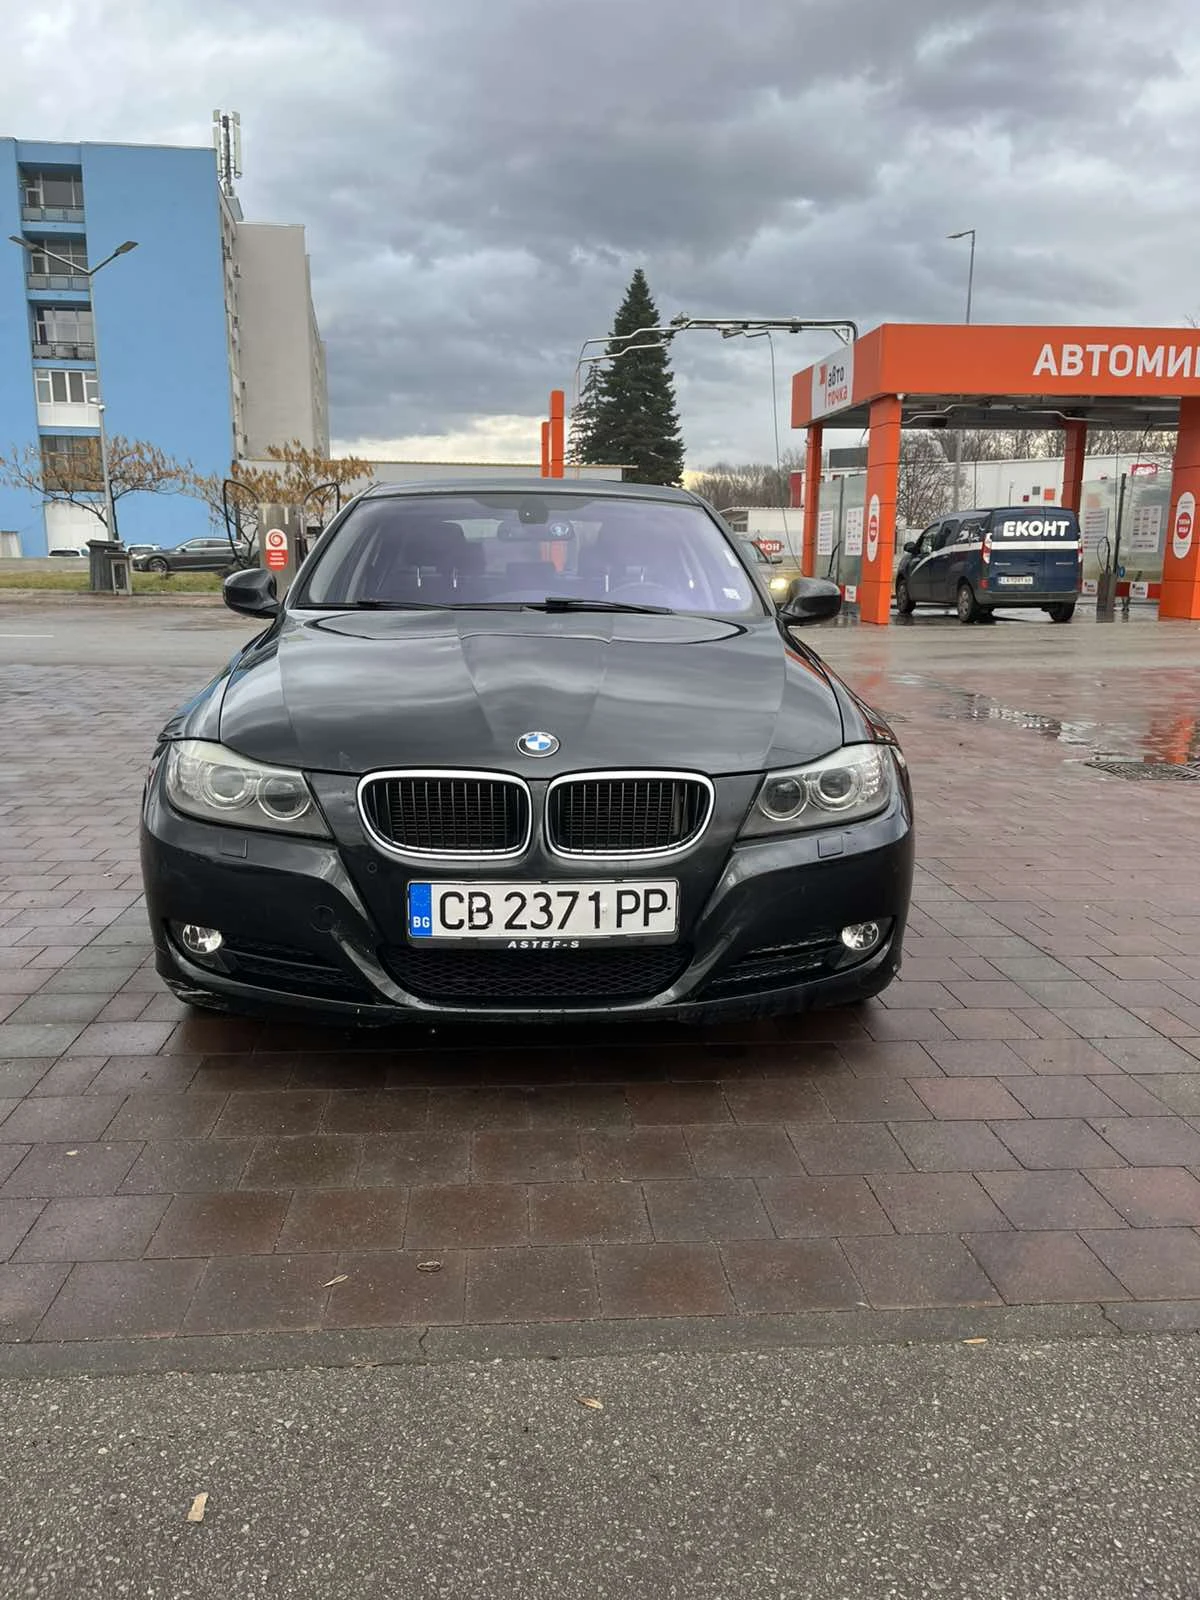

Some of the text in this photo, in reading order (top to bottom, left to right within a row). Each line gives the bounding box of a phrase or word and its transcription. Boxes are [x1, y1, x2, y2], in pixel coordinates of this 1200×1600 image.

[1032, 343, 1200, 378] АВТОМИ
[1003, 520, 1070, 537] ЕКОНТ
[440, 887, 669, 931] CB 2371 PP
[413, 916, 431, 929] BG
[507, 940, 581, 949] ASTEF-S
